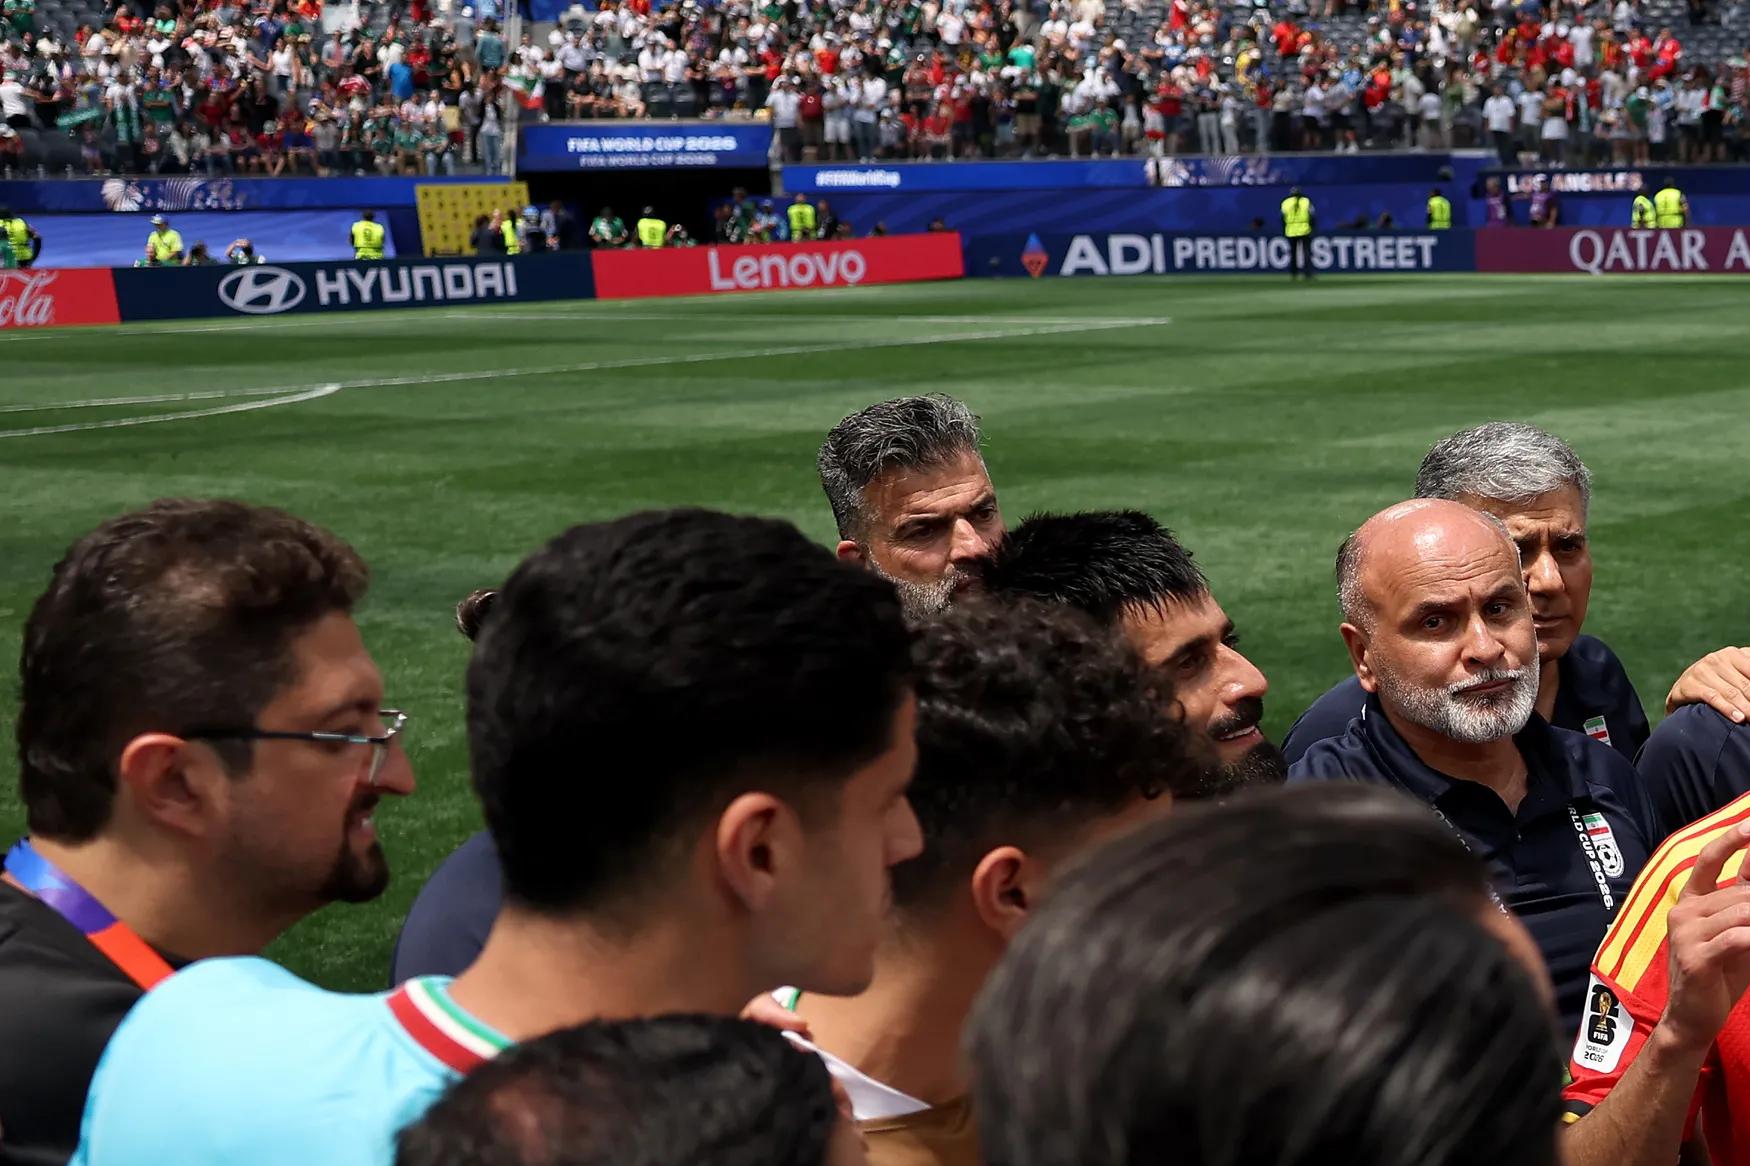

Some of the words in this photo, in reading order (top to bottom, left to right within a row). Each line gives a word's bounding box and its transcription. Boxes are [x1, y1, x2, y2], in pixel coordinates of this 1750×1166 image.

[601, 136, 653, 151] WORLD
[655, 136, 684, 151] CUP
[685, 135, 737, 150] 2026
[708, 248, 866, 290] Lenovo
[1060, 234, 1166, 275] ADI
[1311, 236, 1438, 268] STREET
[1568, 229, 1709, 275] QATAR
[316, 262, 518, 305] HYUNDAI
[1567, 805, 1584, 832] RLD
[1579, 833, 1596, 860] CUP
[1589, 860, 1614, 907] 2026
[1593, 1031, 1608, 1042] FIFA
